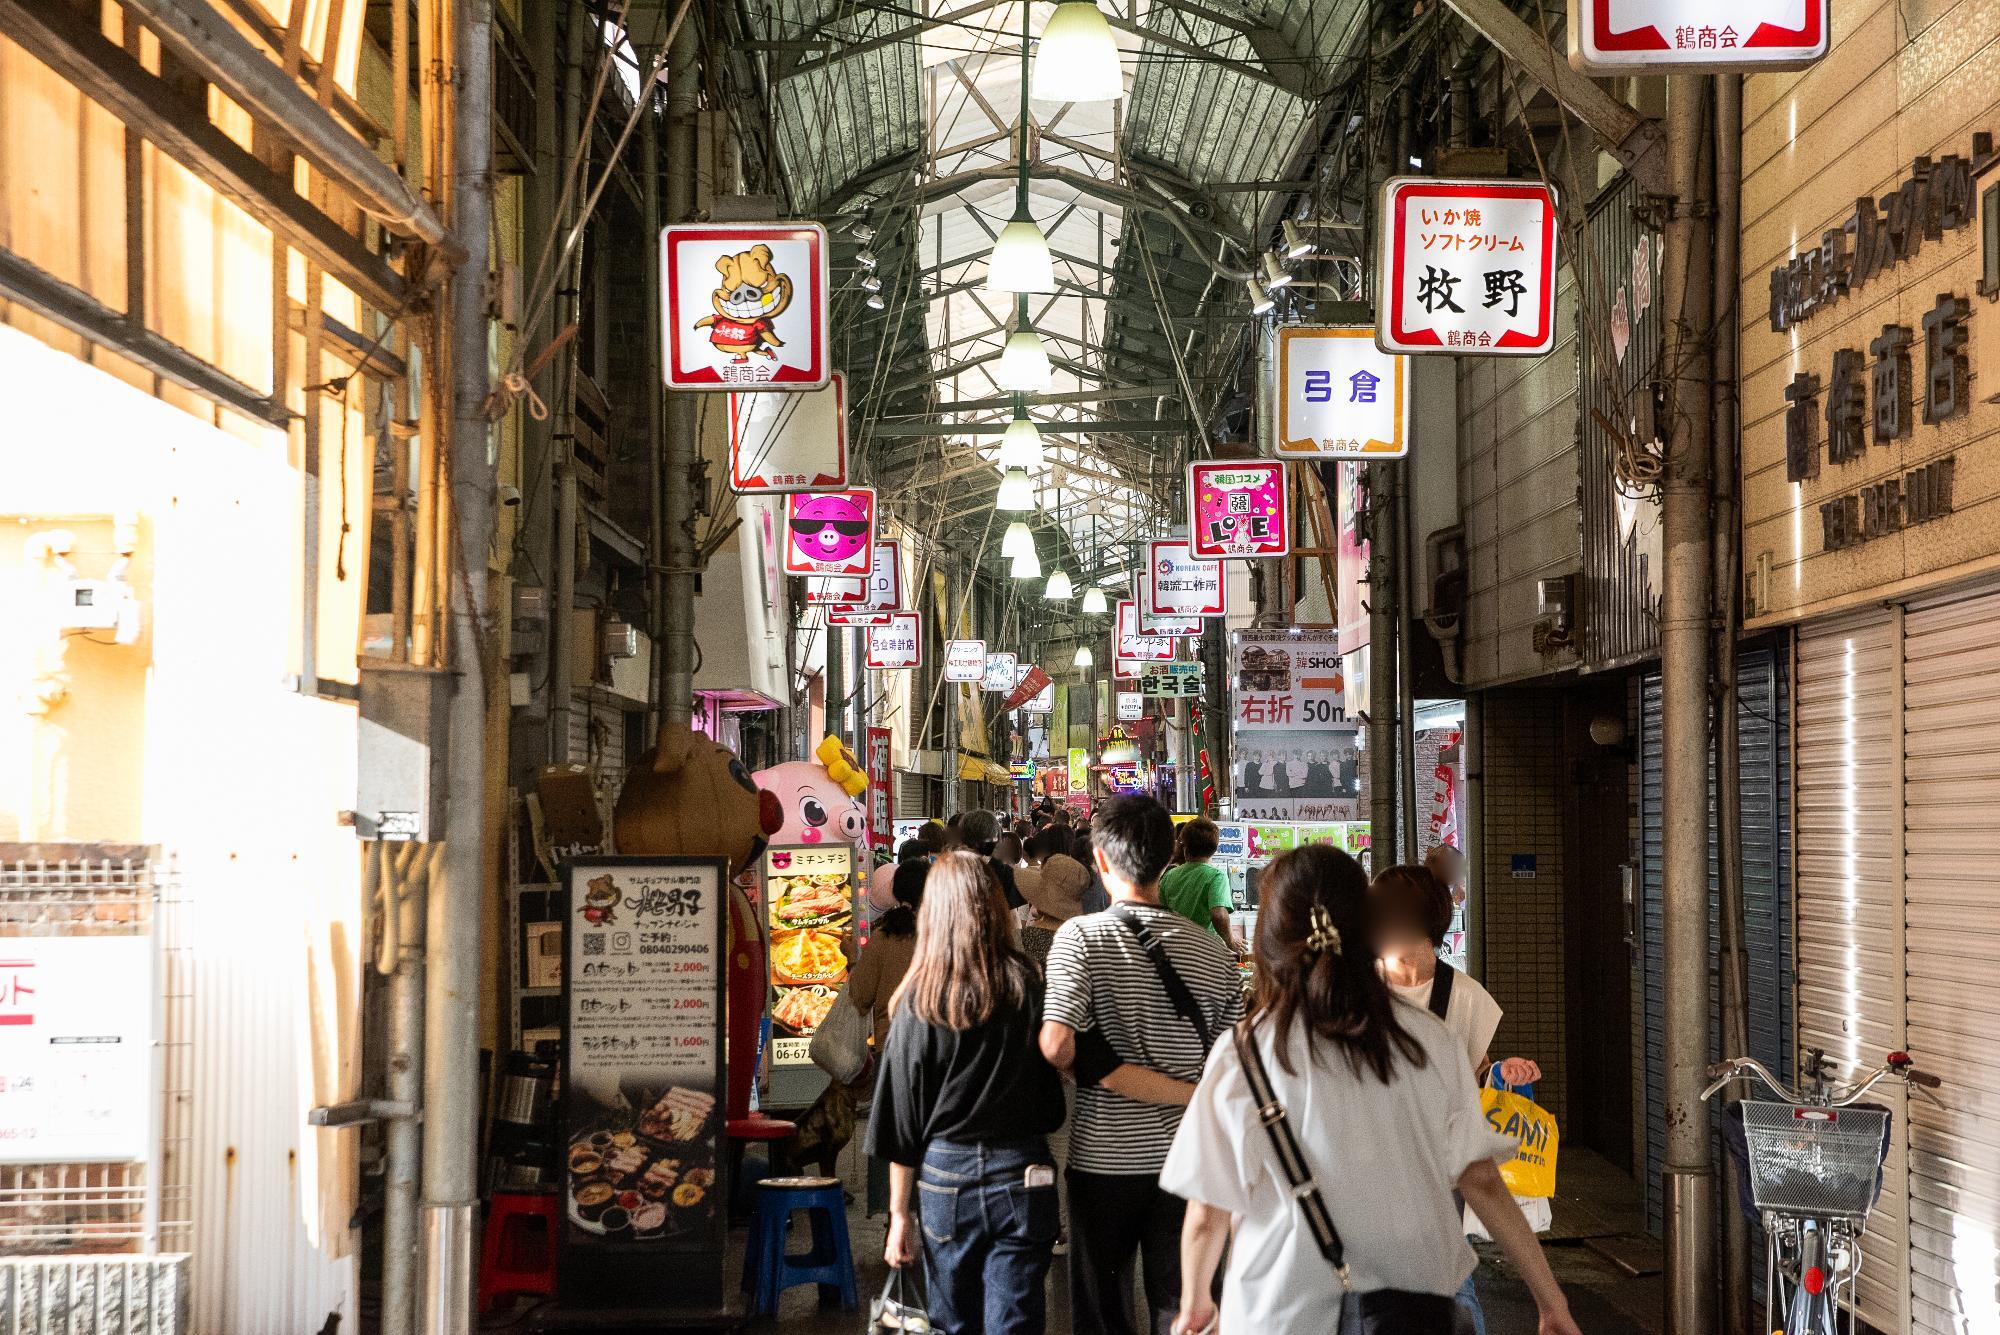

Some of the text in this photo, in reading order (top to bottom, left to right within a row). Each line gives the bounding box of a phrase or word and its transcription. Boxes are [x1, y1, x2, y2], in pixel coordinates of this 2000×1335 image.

[1675, 25, 1739, 50] 鶴商会
[1421, 208, 1482, 227] いか焼
[1420, 232, 1525, 252] ソフトクリーム
[1416, 264, 1528, 318] 牧野
[1447, 329, 1492, 347] 鶴商会
[722, 365, 771, 383] 鶴商会
[1304, 369, 1381, 403] 弓倉
[1322, 438, 1360, 452] 鶴商会
[772, 474, 807, 486] 鶴商会
[1214, 473, 1261, 485] 韓国コスメ
[1210, 516, 1269, 543] LOE
[1228, 543, 1254, 554] 鶴商会
[815, 563, 843, 573] 鶴商会
[1174, 564, 1218, 572] KOREAN CAFE
[1157, 579, 1217, 592] 韓流工作所
[872, 639, 915, 651] 弓倉時計店
[1149, 664, 1198, 675] お酒販売中
[1240, 695, 1294, 725] 右折
[796, 853, 847, 865] ミチンデジ
[640, 945, 709, 954] 08040290406
